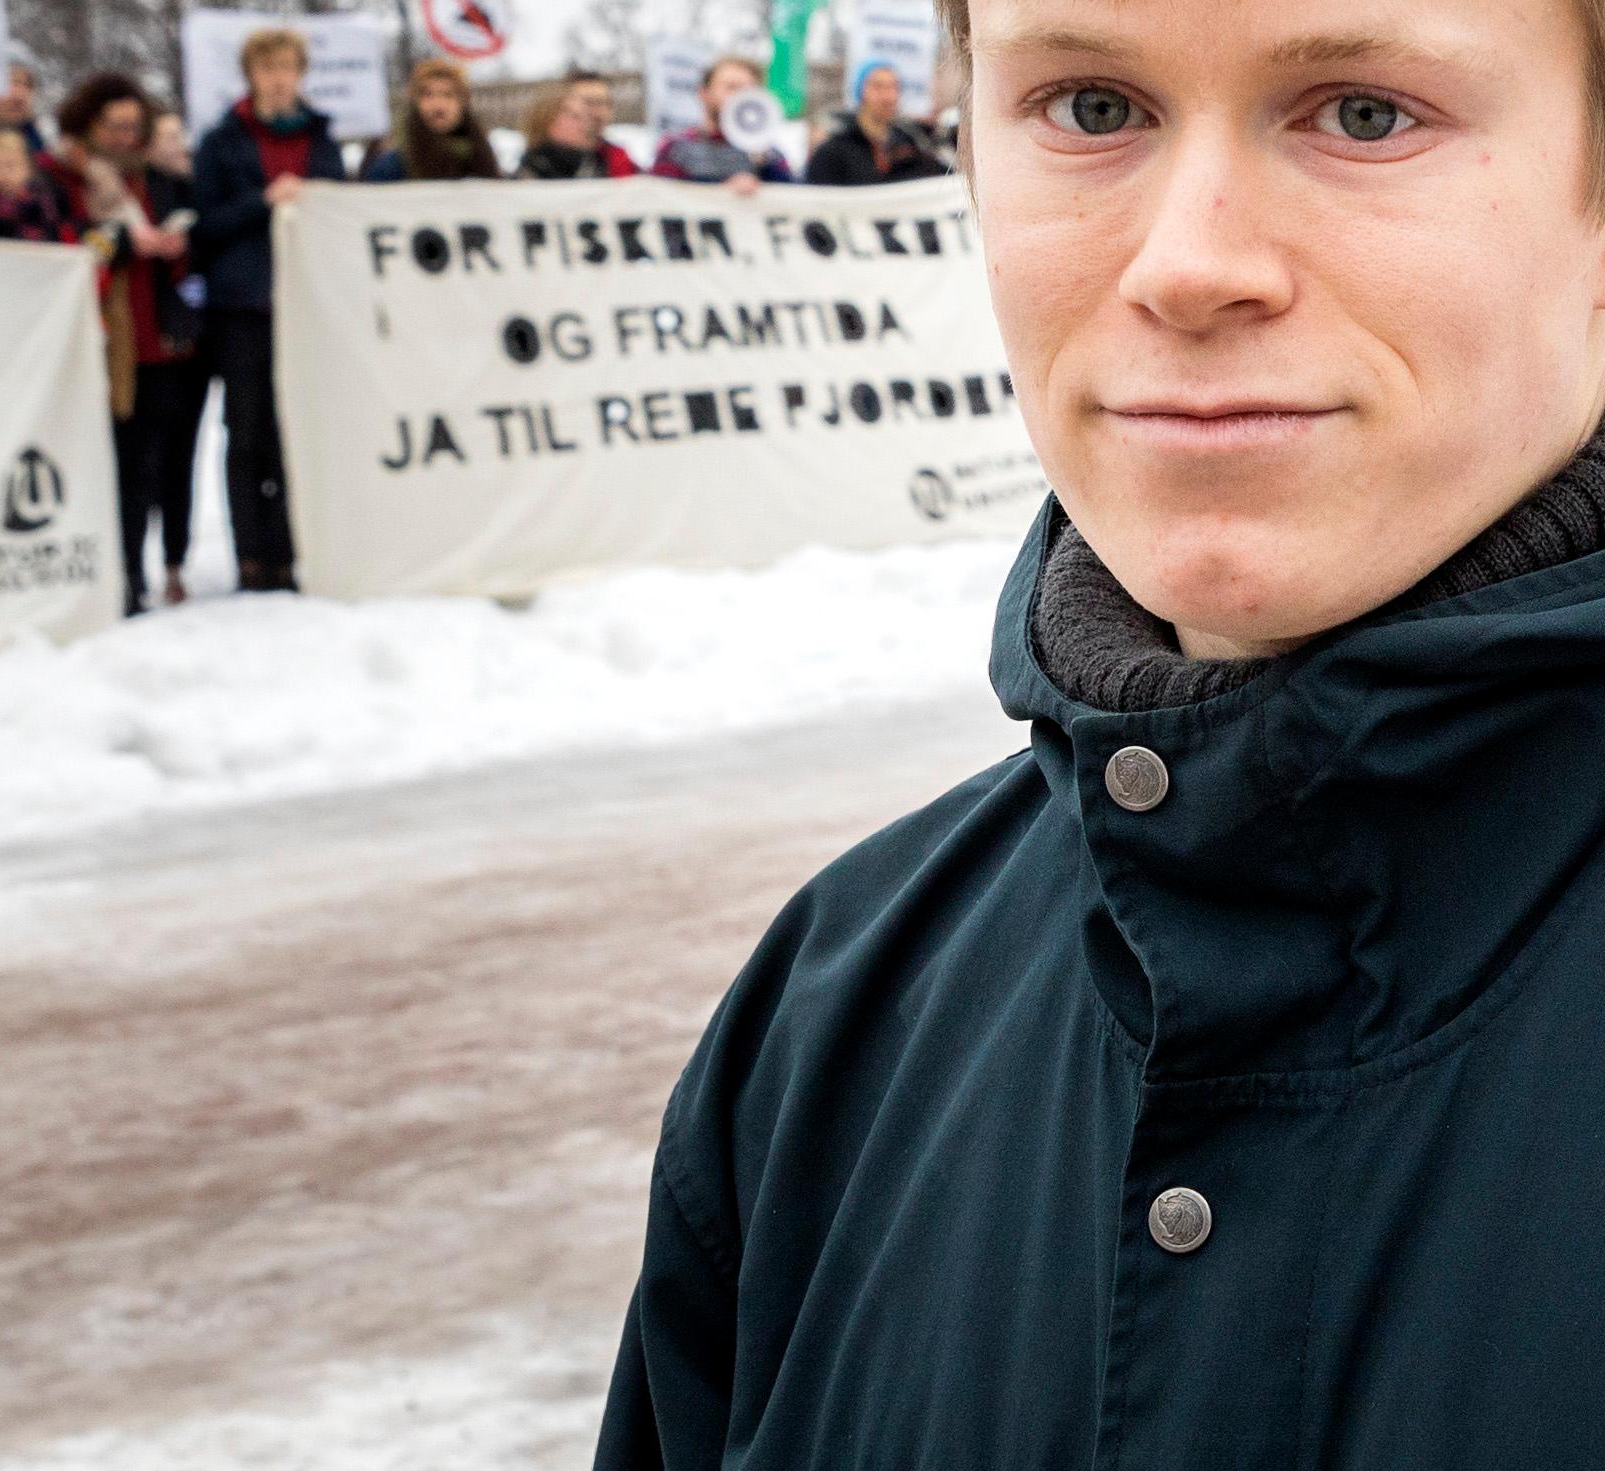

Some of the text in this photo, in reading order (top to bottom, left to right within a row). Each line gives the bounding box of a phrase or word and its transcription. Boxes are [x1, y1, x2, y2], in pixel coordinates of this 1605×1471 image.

[363, 218, 504, 281] FOR
[495, 298, 913, 370] OG FRAMTIDA
[377, 410, 469, 475] JA
[477, 402, 582, 461] TIL
[591, 383, 765, 448] RENE
